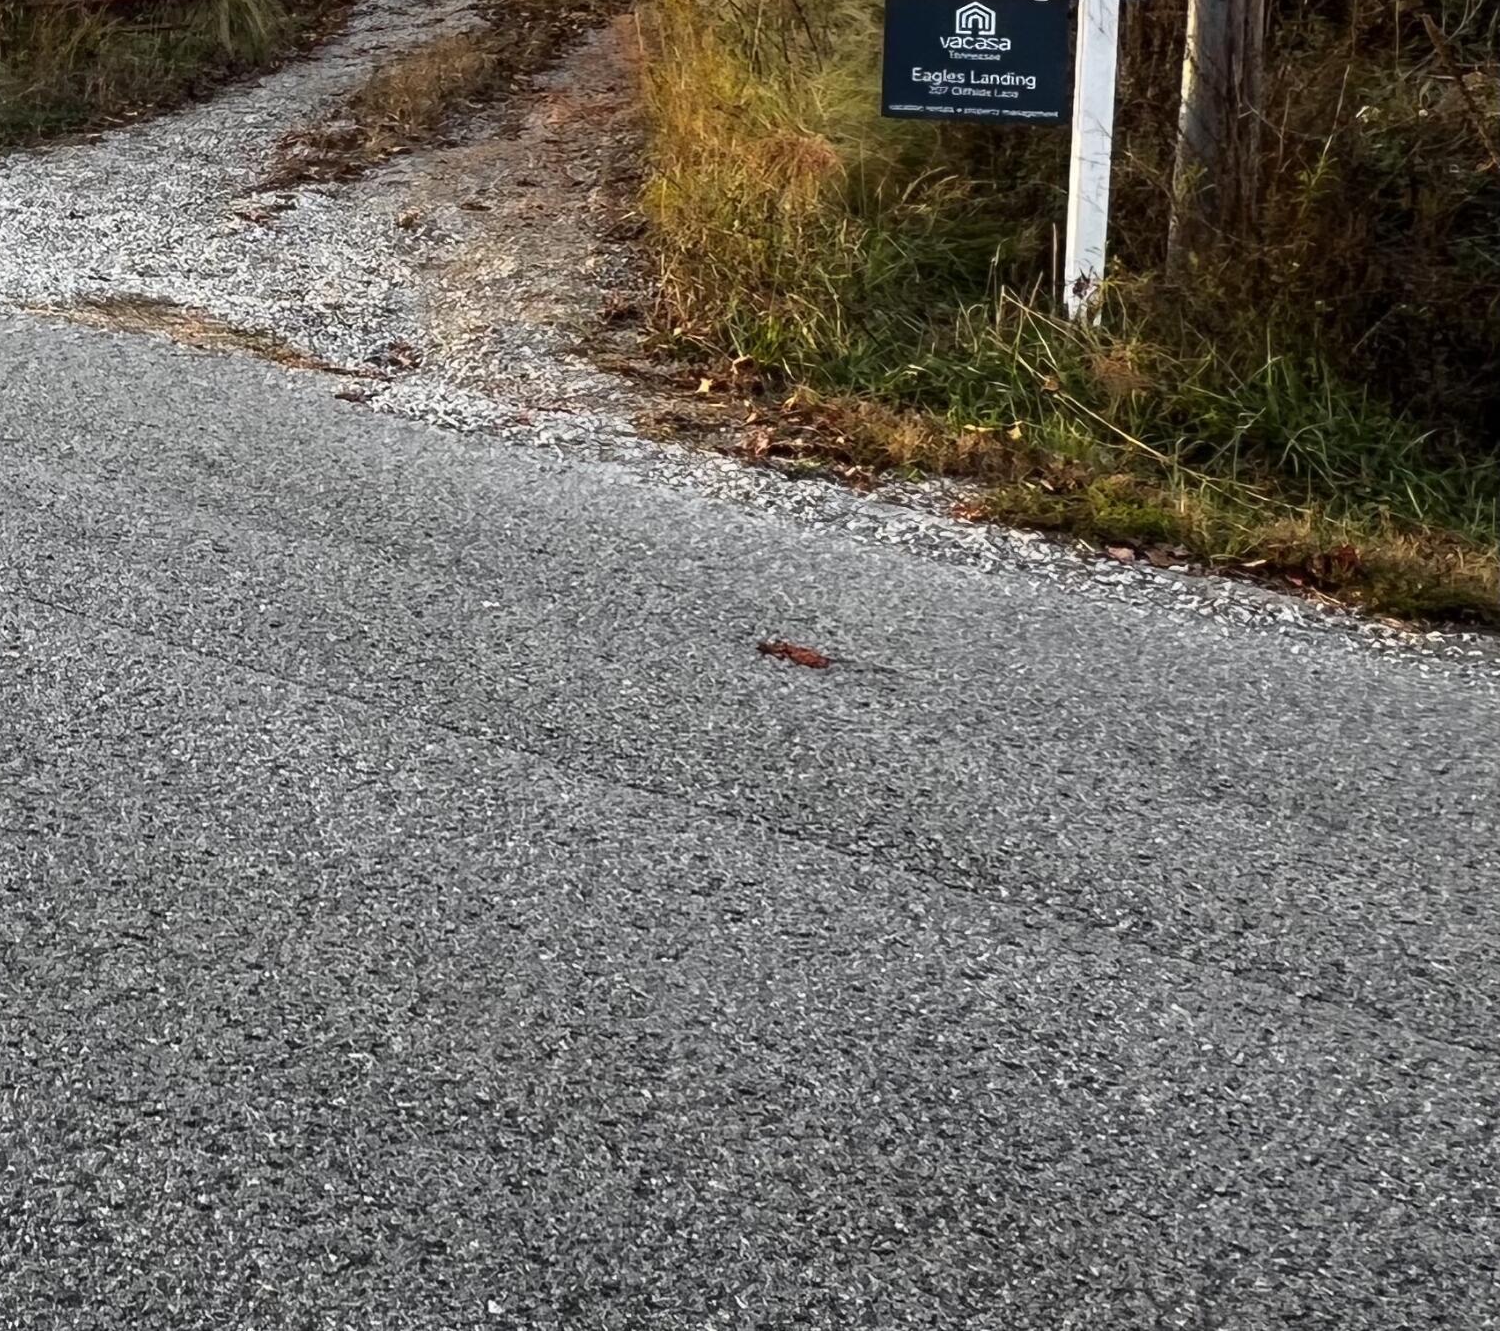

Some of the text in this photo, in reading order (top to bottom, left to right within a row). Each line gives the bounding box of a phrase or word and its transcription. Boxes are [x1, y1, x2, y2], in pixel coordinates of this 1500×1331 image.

[940, 35, 1012, 51] vacasa
[911, 67, 1037, 90] Eagles Landing
